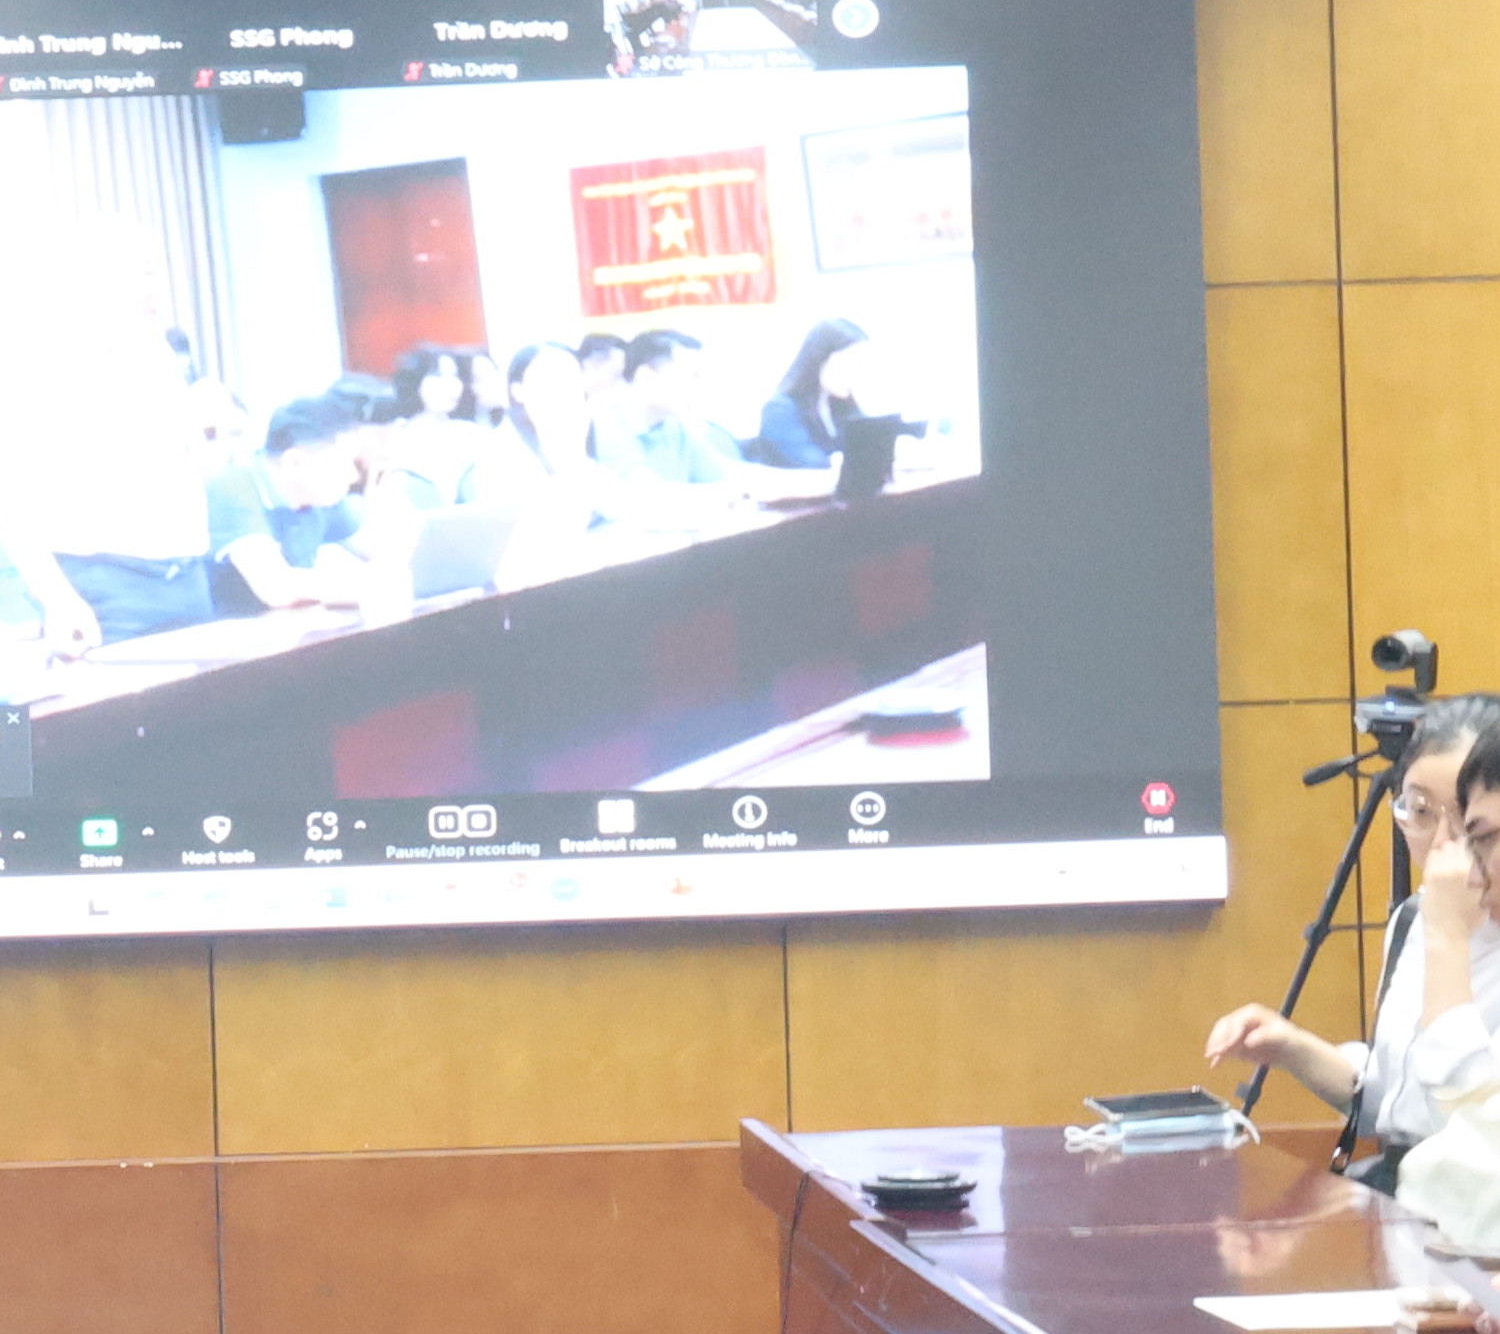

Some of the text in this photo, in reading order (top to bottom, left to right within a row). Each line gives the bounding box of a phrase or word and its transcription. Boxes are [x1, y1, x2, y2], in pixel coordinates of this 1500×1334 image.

[38, 35, 107, 57] Trung
[229, 26, 354, 49] SSG Phong
[219, 68, 304, 88] SSG Phong
[1143, 817, 1175, 835] End
[702, 832, 765, 851] Meeting
[848, 827, 889, 844] More
[304, 845, 343, 863] Apps
[385, 840, 541, 861] Pause/stop recording
[560, 836, 677, 854] Breakout rooms
[79, 853, 123, 869] Share
[182, 848, 256, 866] Host tools
